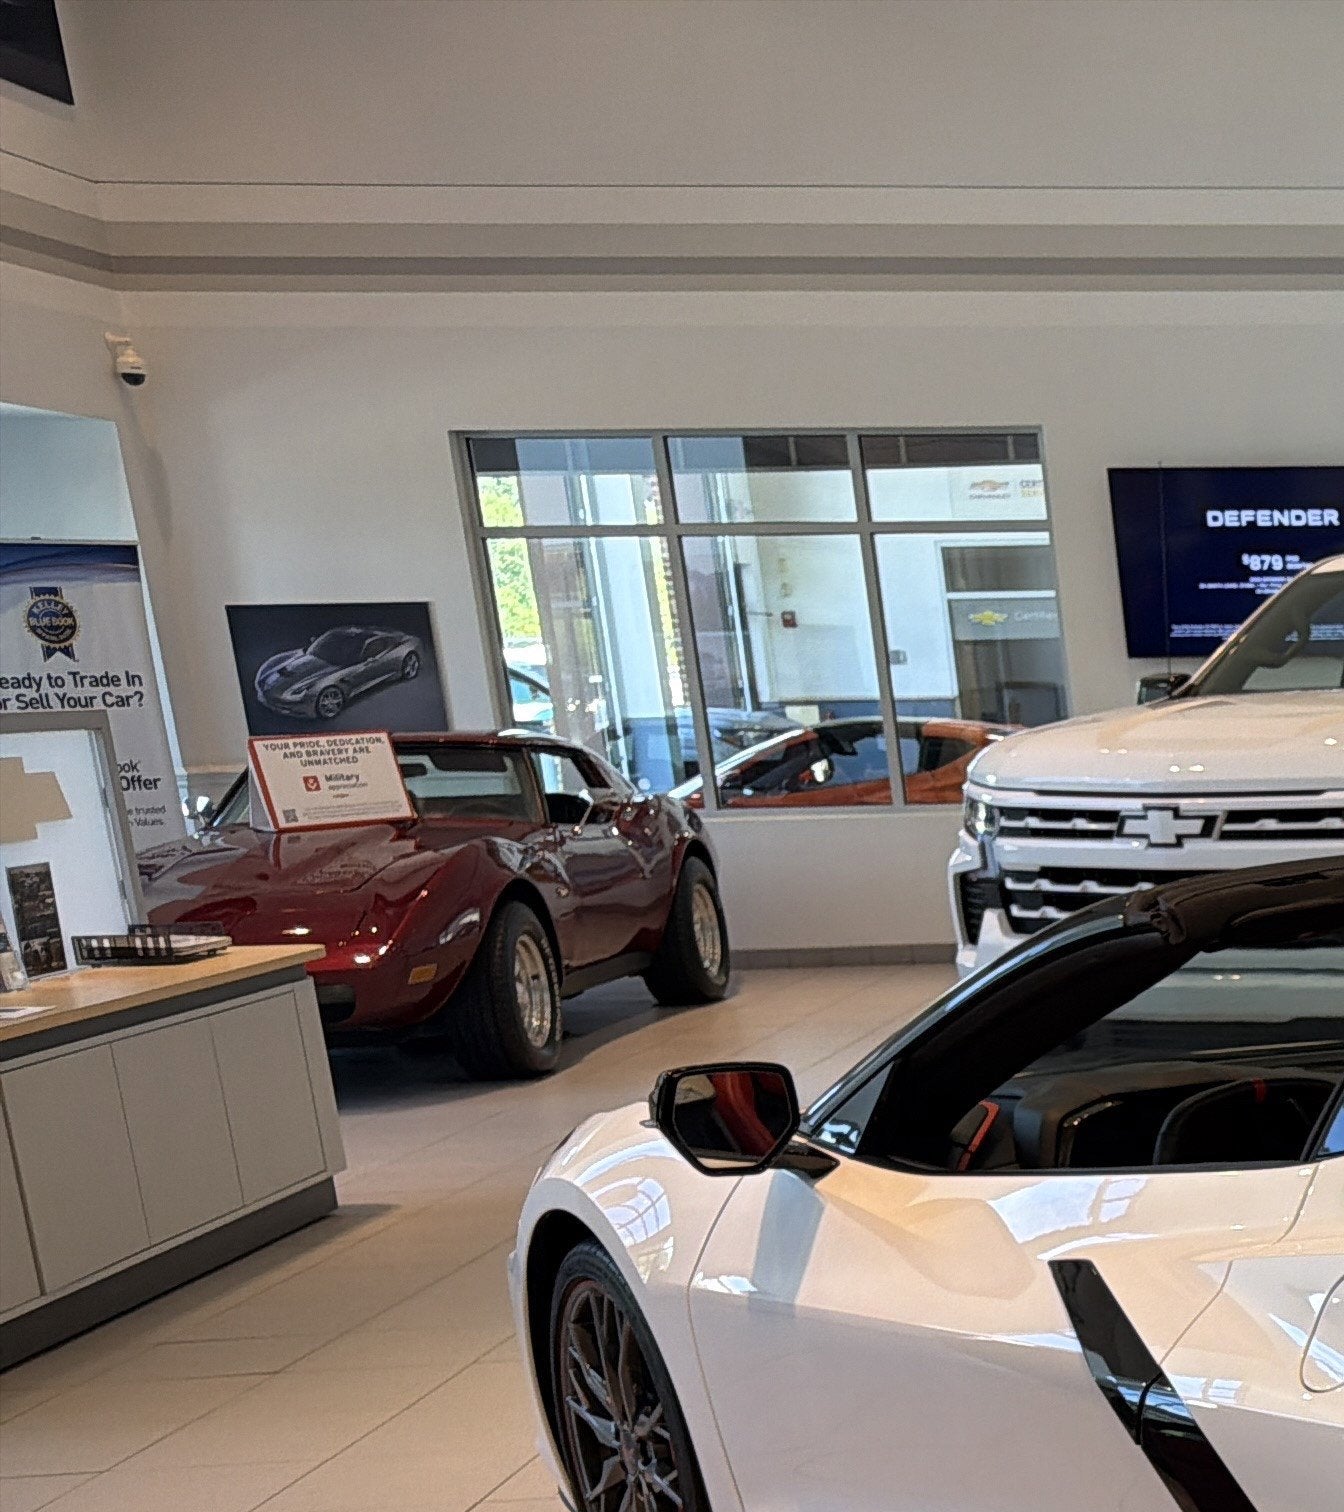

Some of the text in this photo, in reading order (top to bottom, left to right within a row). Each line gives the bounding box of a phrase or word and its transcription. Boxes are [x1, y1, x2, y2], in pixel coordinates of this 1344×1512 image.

[1206, 509, 1340, 527] DEFENDER
[31, 600, 69, 614] KELLEY
[29, 617, 75, 627] BLUE BOOK
[0, 670, 143, 693] eady to Trade In
[15, 693, 53, 710] Sell
[54, 692, 98, 709] Your
[101, 690, 144, 707] Car?
[263, 736, 386, 751] YOUR PRIDE, DEDICATION,
[282, 746, 372, 760] AND BRAVERY ARE
[300, 755, 359, 767] UNMATCHED
[120, 775, 161, 791] Offer
[324, 774, 360, 783] Military
